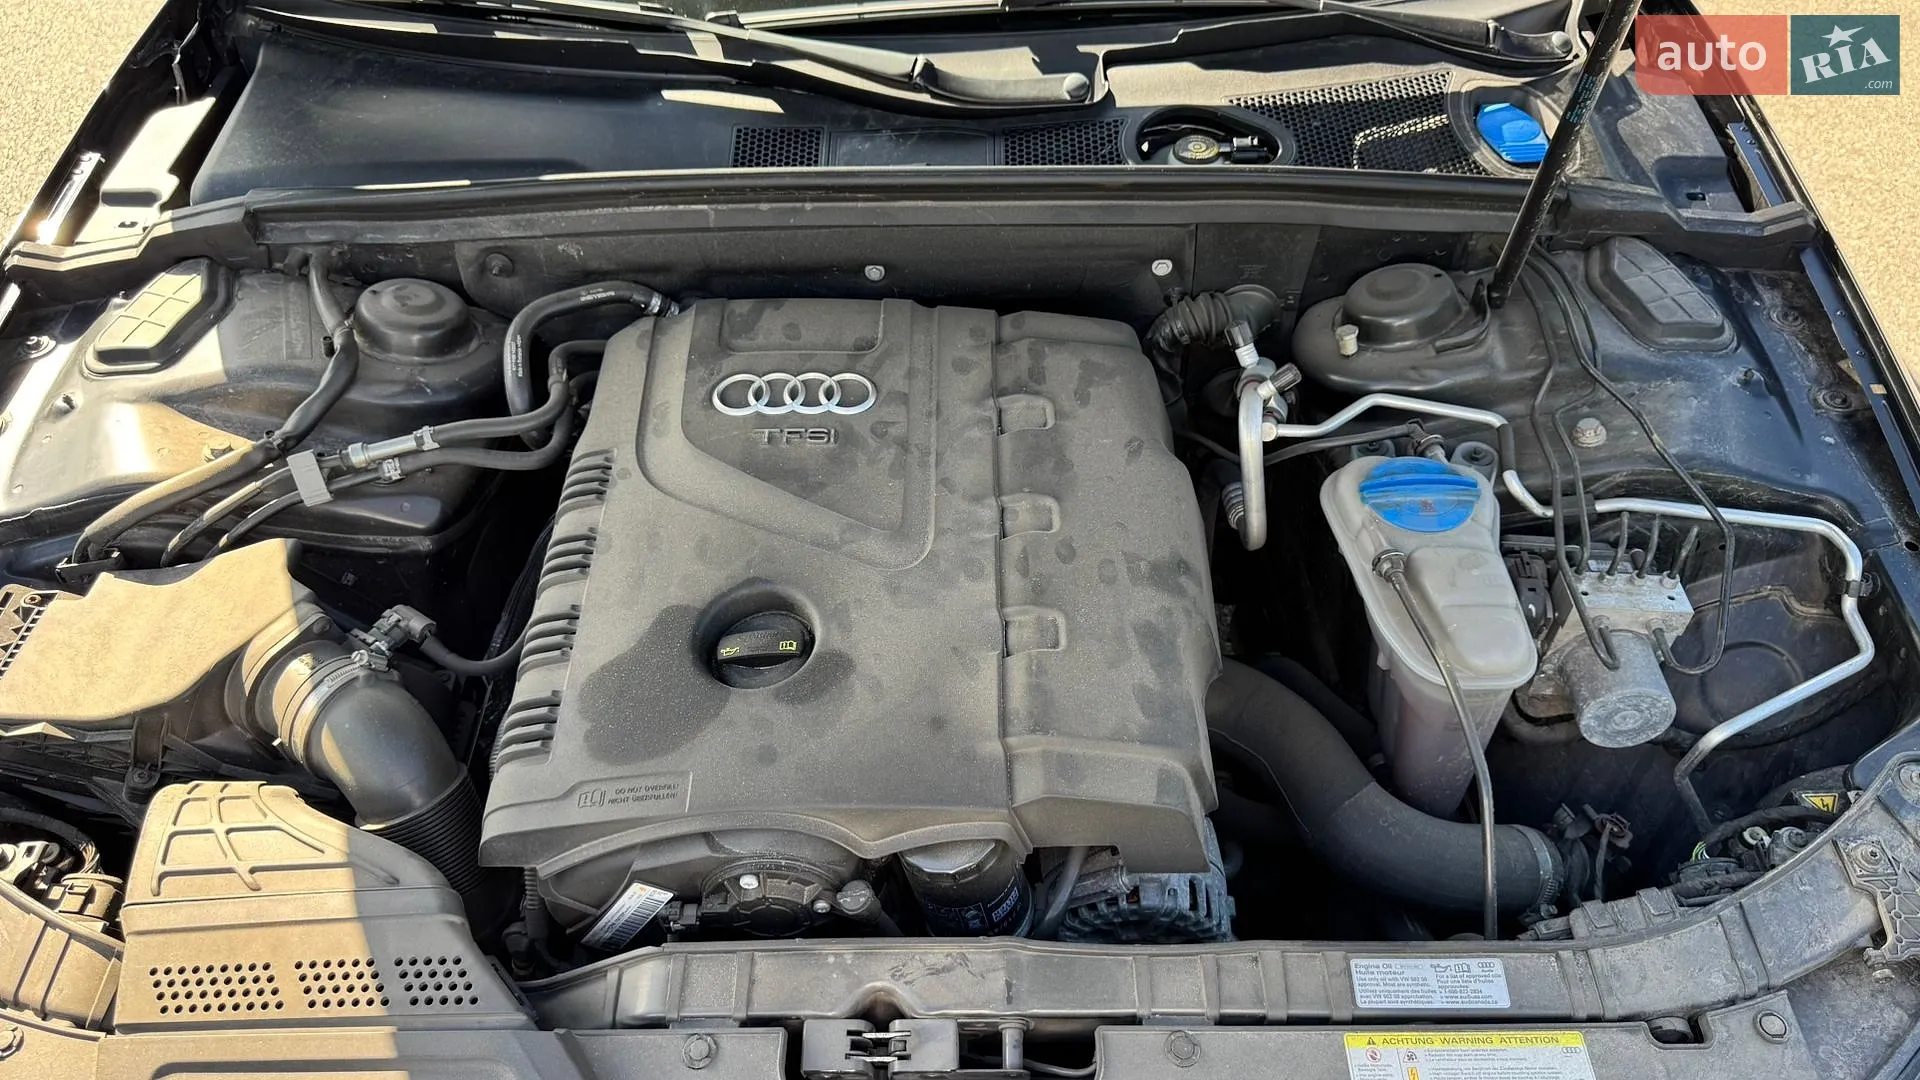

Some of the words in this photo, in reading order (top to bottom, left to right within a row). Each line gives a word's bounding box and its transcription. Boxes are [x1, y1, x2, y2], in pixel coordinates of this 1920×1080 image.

[752, 427, 838, 445] TFSI
[1382, 1037, 1434, 1045] ACHTUNG
[1440, 1036, 1494, 1044] WARNING
[1499, 1036, 1559, 1044] ATTENTION
